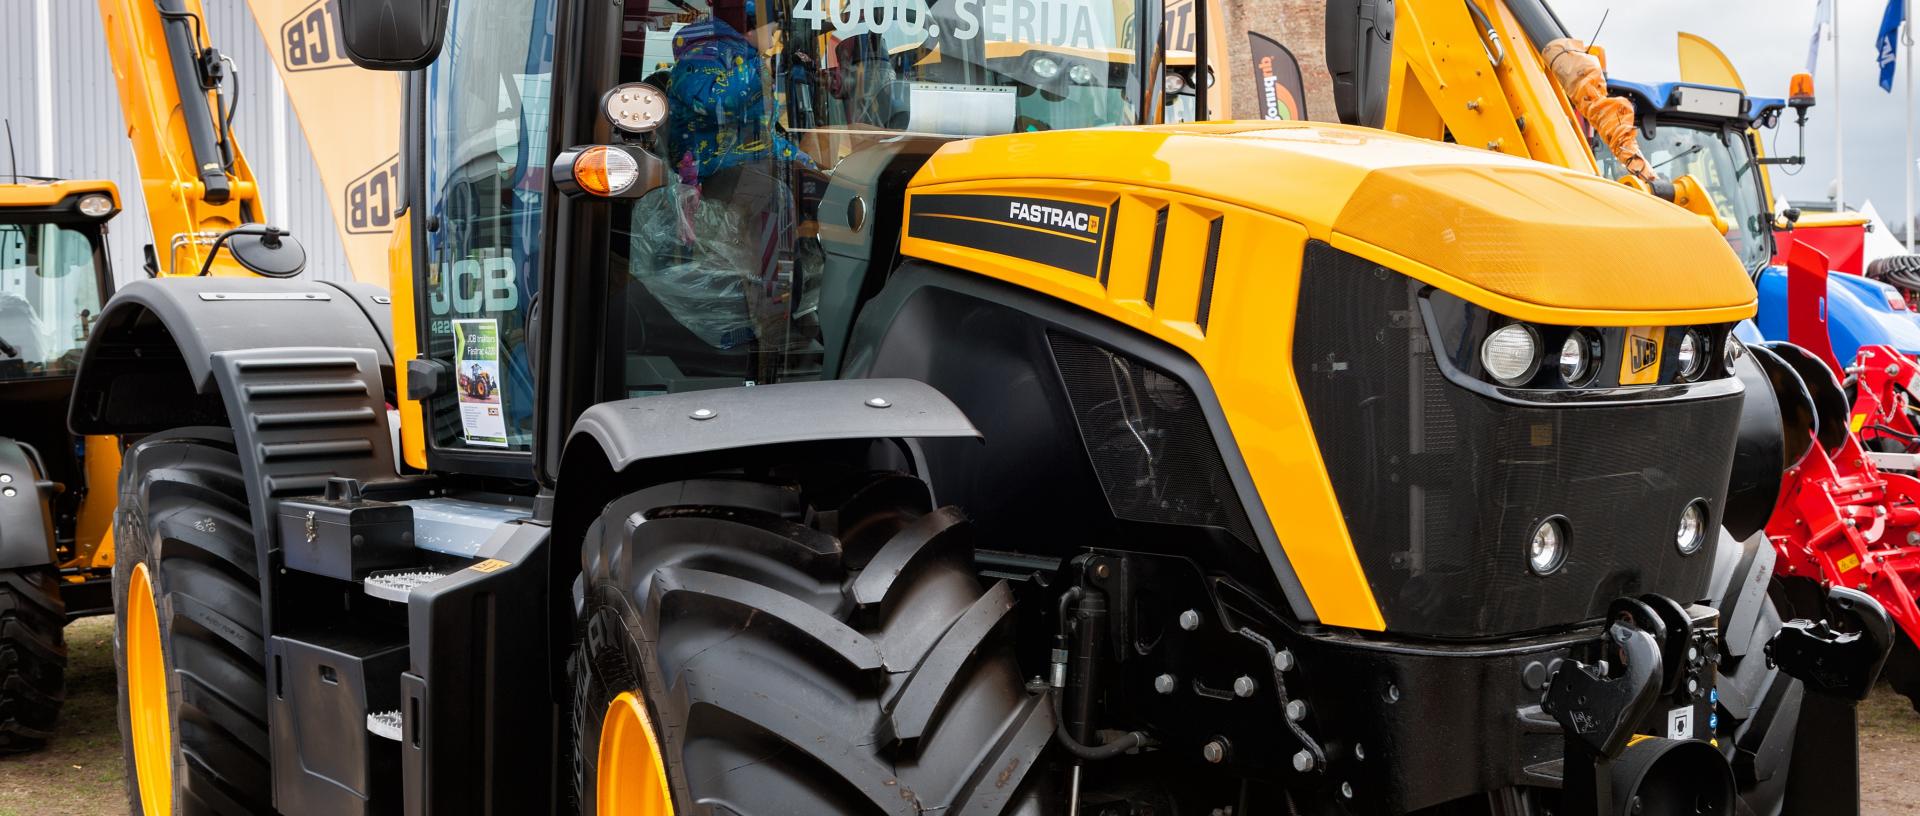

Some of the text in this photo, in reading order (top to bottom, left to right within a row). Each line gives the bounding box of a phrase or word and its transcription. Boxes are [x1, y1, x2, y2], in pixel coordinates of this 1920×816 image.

[953, 0, 1095, 50] SERIJA
[1009, 201, 1089, 231] FASTRAC
[430, 256, 518, 315] JCB
[1633, 339, 1656, 370] JCB
